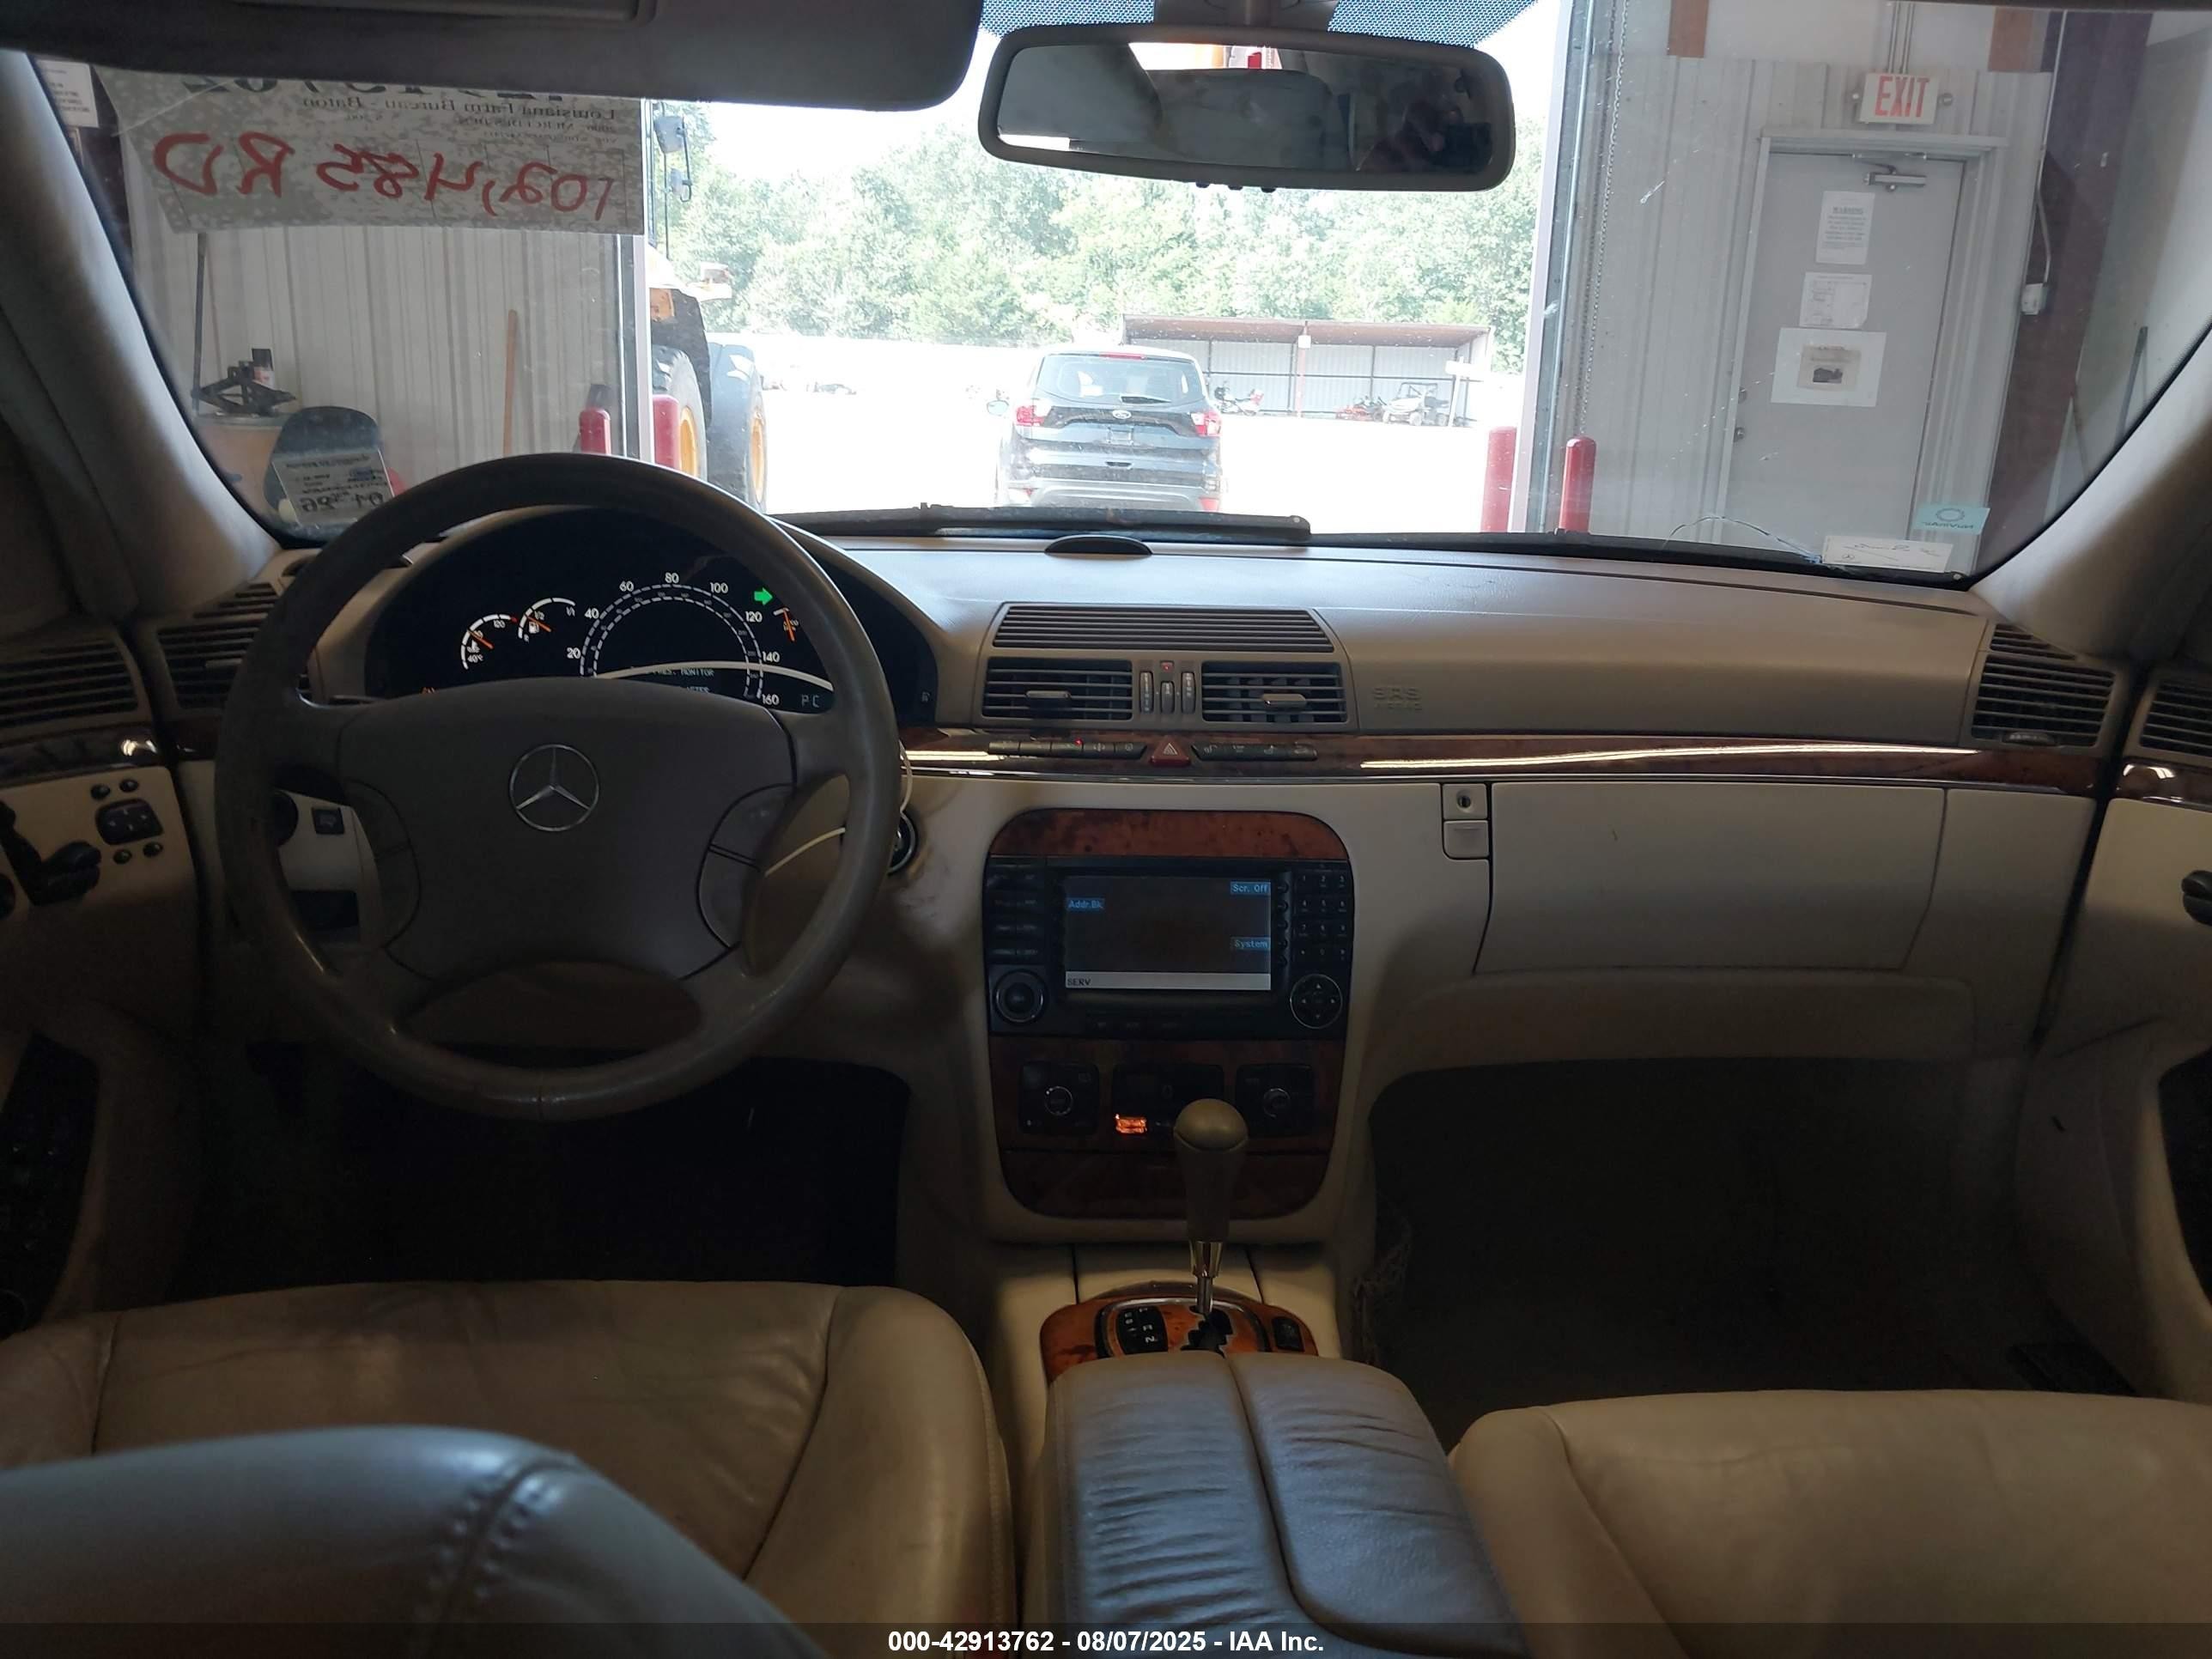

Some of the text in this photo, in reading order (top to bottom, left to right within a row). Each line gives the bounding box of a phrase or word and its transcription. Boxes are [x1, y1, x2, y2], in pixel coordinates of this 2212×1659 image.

[1875, 76, 1930, 118] EXIT
[665, 572, 680, 584] 80
[618, 580, 635, 592] 60
[709, 581, 729, 593] 100
[584, 607, 600, 619] 40
[744, 611, 763, 623] 120
[566, 647, 581, 659] 20
[762, 651, 781, 664] 140
[680, 667, 714, 678] MONITOR
[1373, 687, 1422, 700] SRS
[761, 694, 781, 707] 160
[1254, 884, 1268, 893] Off
[1235, 939, 1268, 950] System
[1066, 977, 1091, 987] SERV
